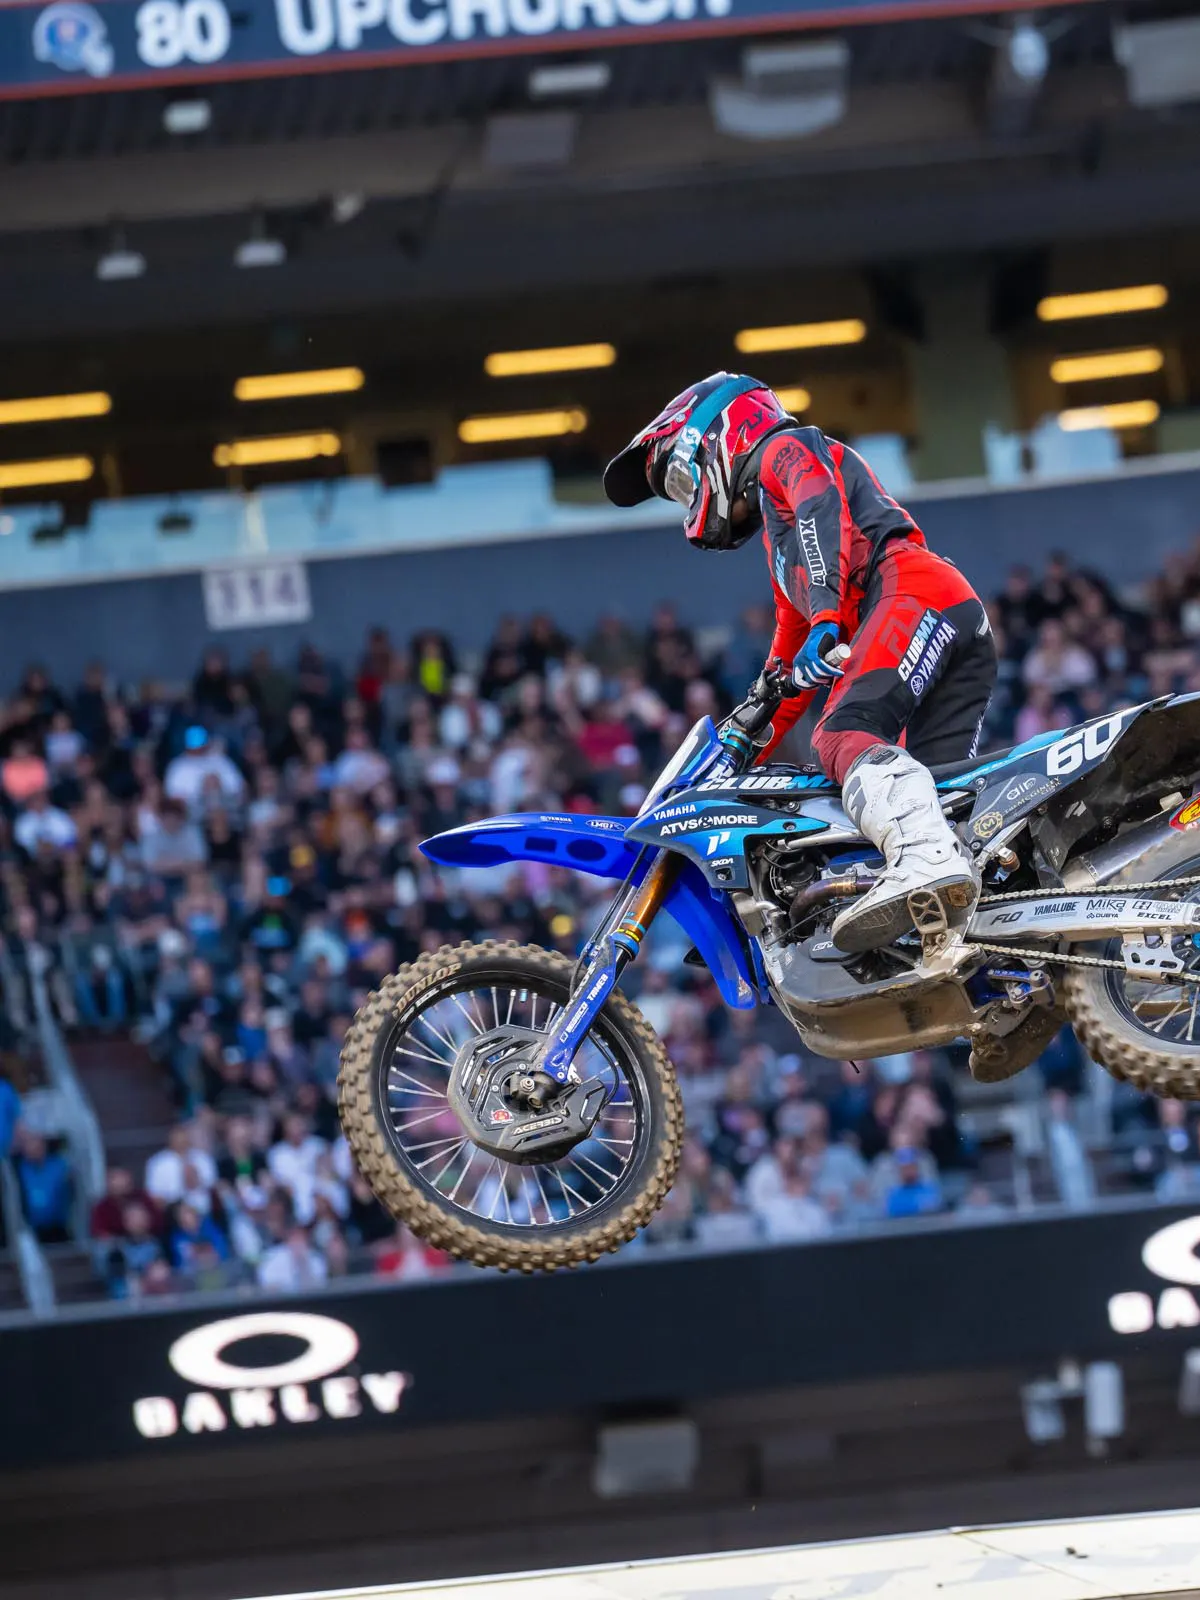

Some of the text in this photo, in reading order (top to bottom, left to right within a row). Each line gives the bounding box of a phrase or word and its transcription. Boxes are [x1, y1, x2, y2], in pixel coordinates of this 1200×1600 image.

[135, 0, 732, 67] 80 UPCHU
[897, 609, 938, 682] CLUBMX
[918, 621, 957, 681] YAMAHA
[1046, 713, 1123, 777] 60
[696, 774, 834, 792] CLUBM
[653, 804, 697, 820] YAMAHA
[1034, 901, 1080, 916] YAMALUBE
[1137, 912, 1172, 921] EXCEL
[394, 962, 462, 1015] DUNLOP
[131, 1370, 407, 1438] OAKLEY
